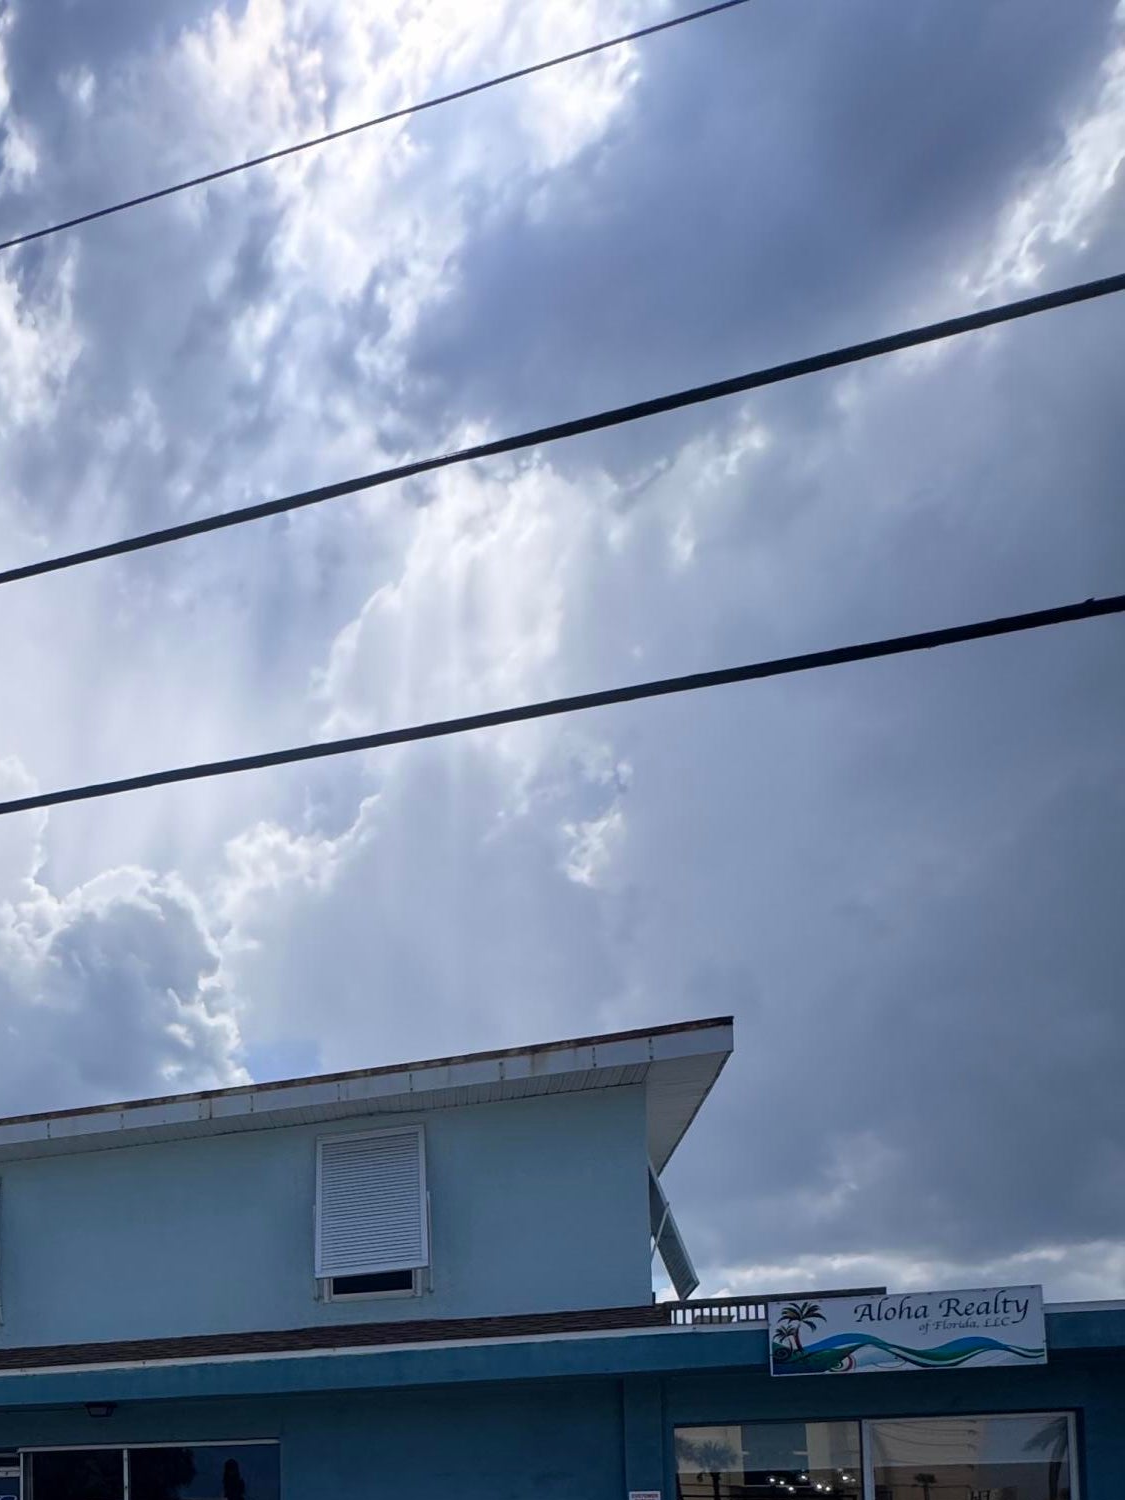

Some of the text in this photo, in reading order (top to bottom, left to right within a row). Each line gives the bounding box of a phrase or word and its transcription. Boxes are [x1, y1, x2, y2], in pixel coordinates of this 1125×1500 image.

[854, 1290, 1029, 1324] Aloha Realty
[918, 1321, 931, 1335] of
[983, 1316, 1011, 1328] LLC
